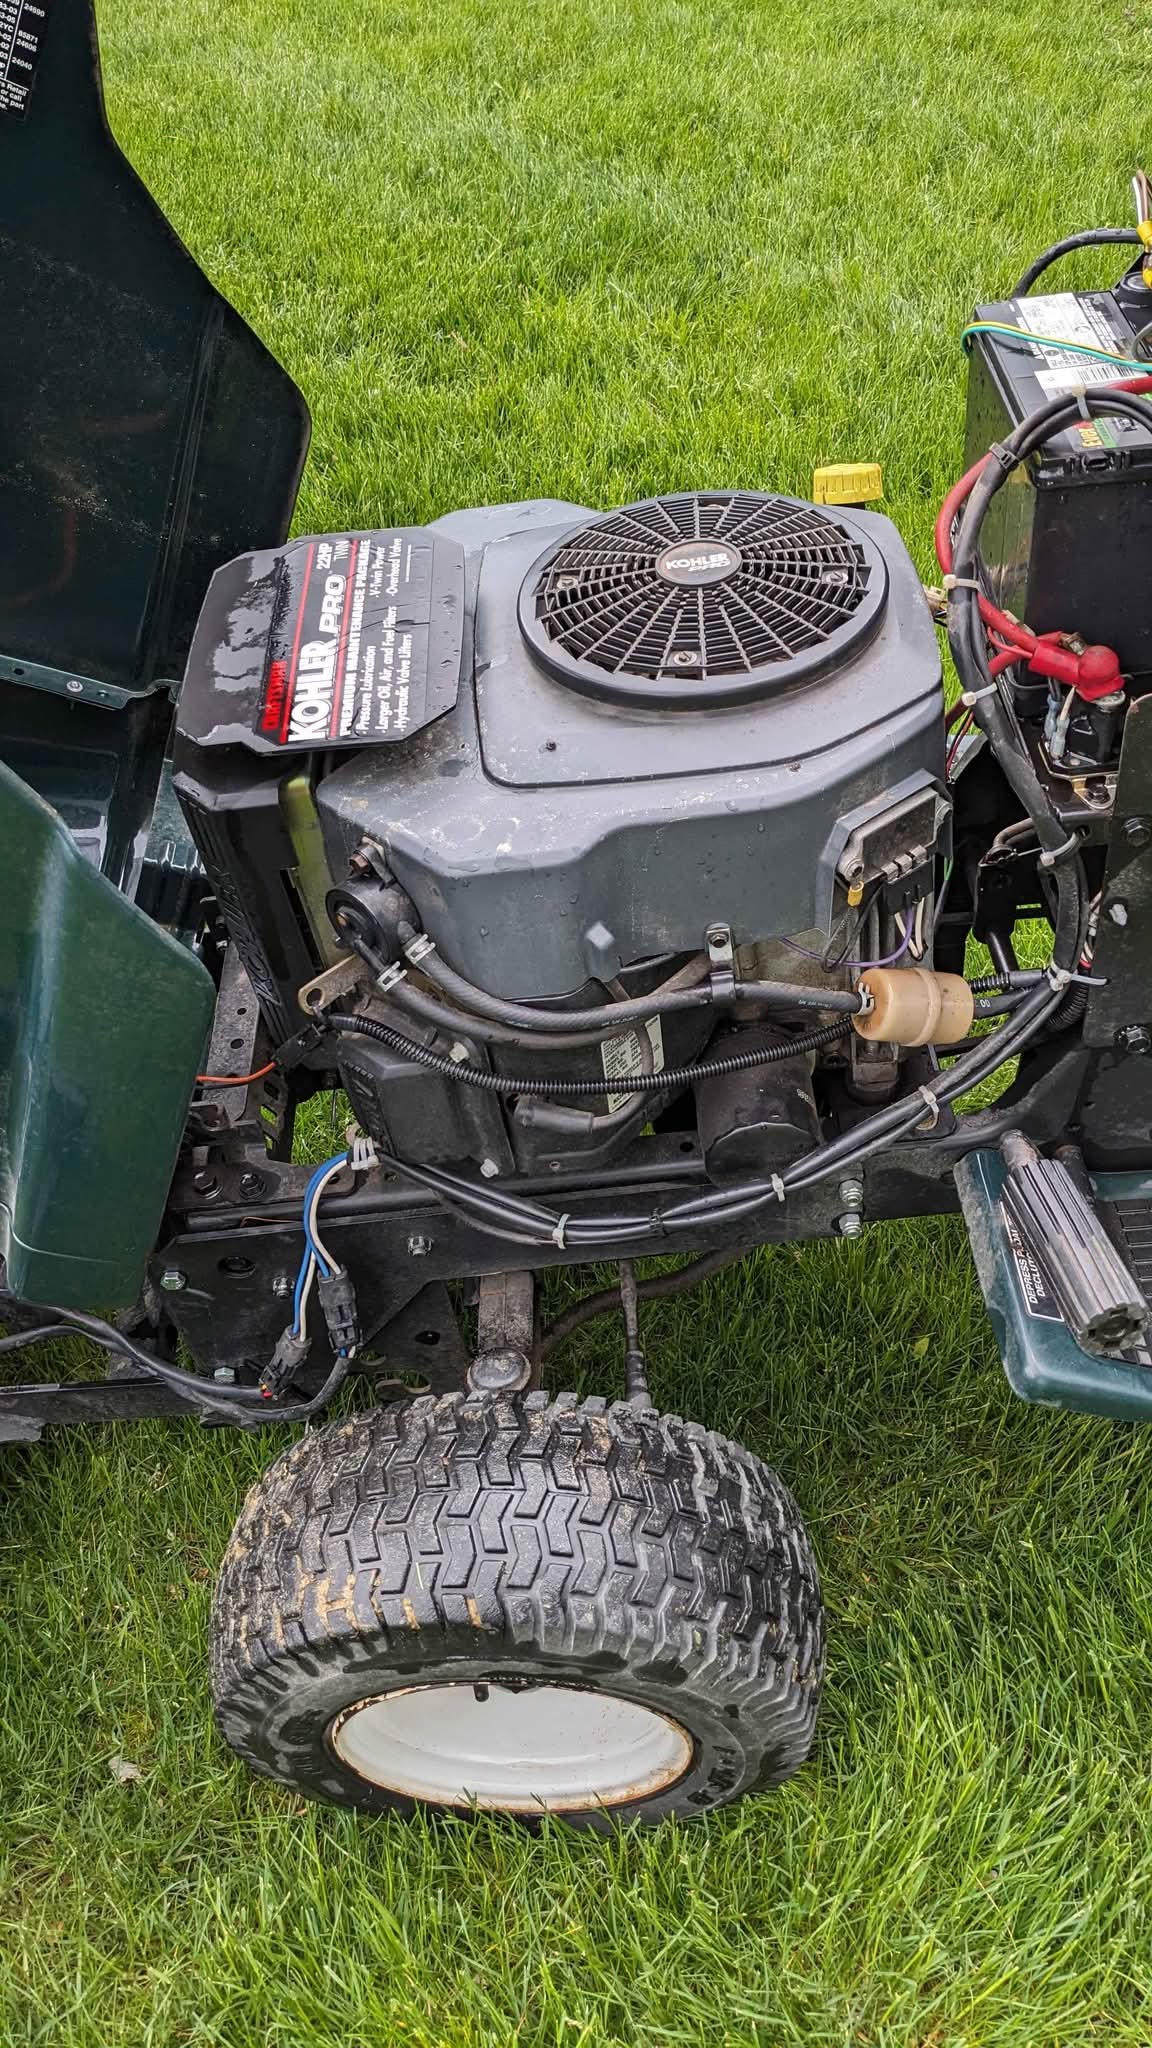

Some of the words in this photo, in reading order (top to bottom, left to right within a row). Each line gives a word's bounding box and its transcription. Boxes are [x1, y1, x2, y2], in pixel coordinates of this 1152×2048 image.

[7, 83, 27, 97] Retail
[10, 93, 22, 102] call
[10, 100, 25, 110] part
[316, 542, 333, 570] 22HP
[372, 547, 385, 569] Power
[389, 537, 402, 557] Valve
[355, 540, 371, 588] PACKAGE
[665, 553, 729, 569] KOHLER
[383, 605, 398, 628] Filters
[346, 589, 367, 670] MAINTENANCE
[383, 629, 396, 646] Fuel
[288, 640, 336, 742] KOHLER
[319, 573, 347, 635] PRO
[382, 648, 395, 664] and
[398, 633, 413, 659] Lifters
[360, 645, 376, 691] Lubrication
[398, 660, 412, 685] Valve
[262, 660, 288, 731] CRAFTSMAN
[340, 673, 358, 737] PREMIUM
[1018, 1258, 1039, 1304] DEPRESS
